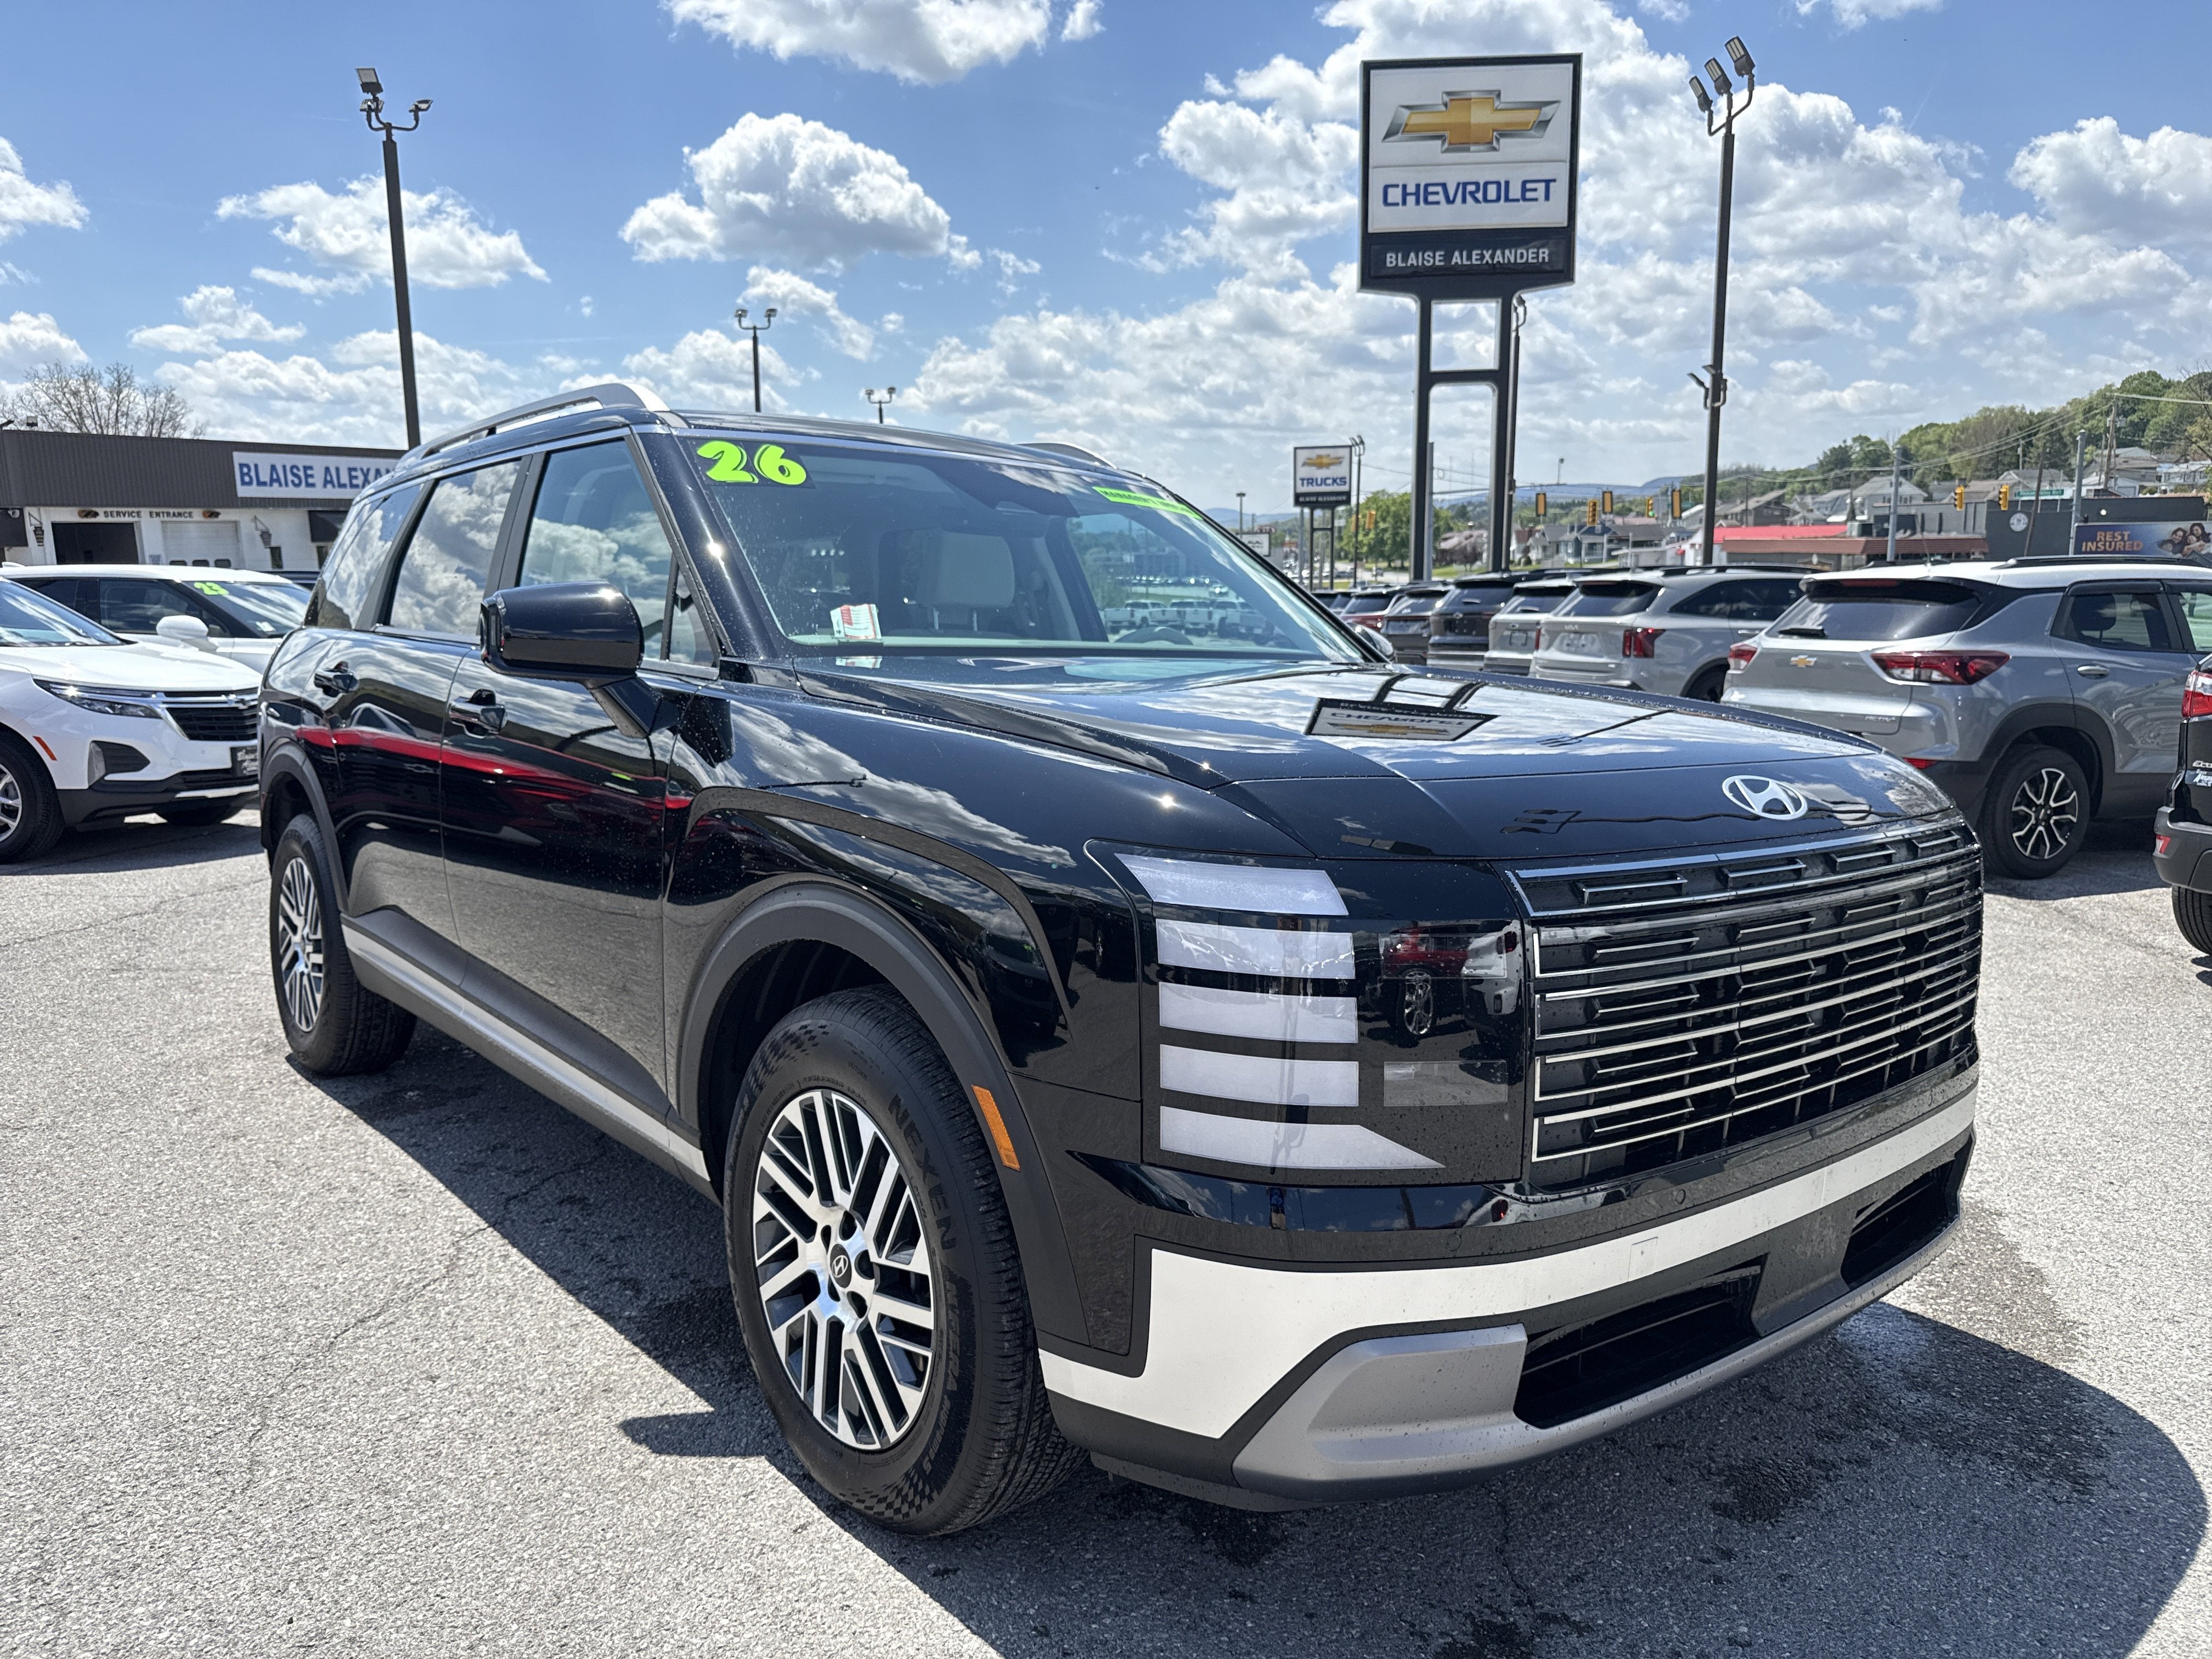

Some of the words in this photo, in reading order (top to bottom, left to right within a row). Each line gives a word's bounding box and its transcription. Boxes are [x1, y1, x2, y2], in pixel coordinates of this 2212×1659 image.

[1383, 178, 1556, 207] CHEVROLET
[1386, 250, 1445, 267] BLAISE
[1451, 248, 1549, 266] ALEXANDER
[697, 441, 806, 485] 26
[238, 462, 317, 488] BLAISE
[1299, 477, 1347, 487] TRUCKS
[104, 510, 142, 518] SERVICE
[149, 511, 194, 519] ENTRANCE
[2081, 540, 2143, 552] INSURED
[2096, 531, 2131, 542] REST
[887, 1093, 958, 1250] NEXEN
